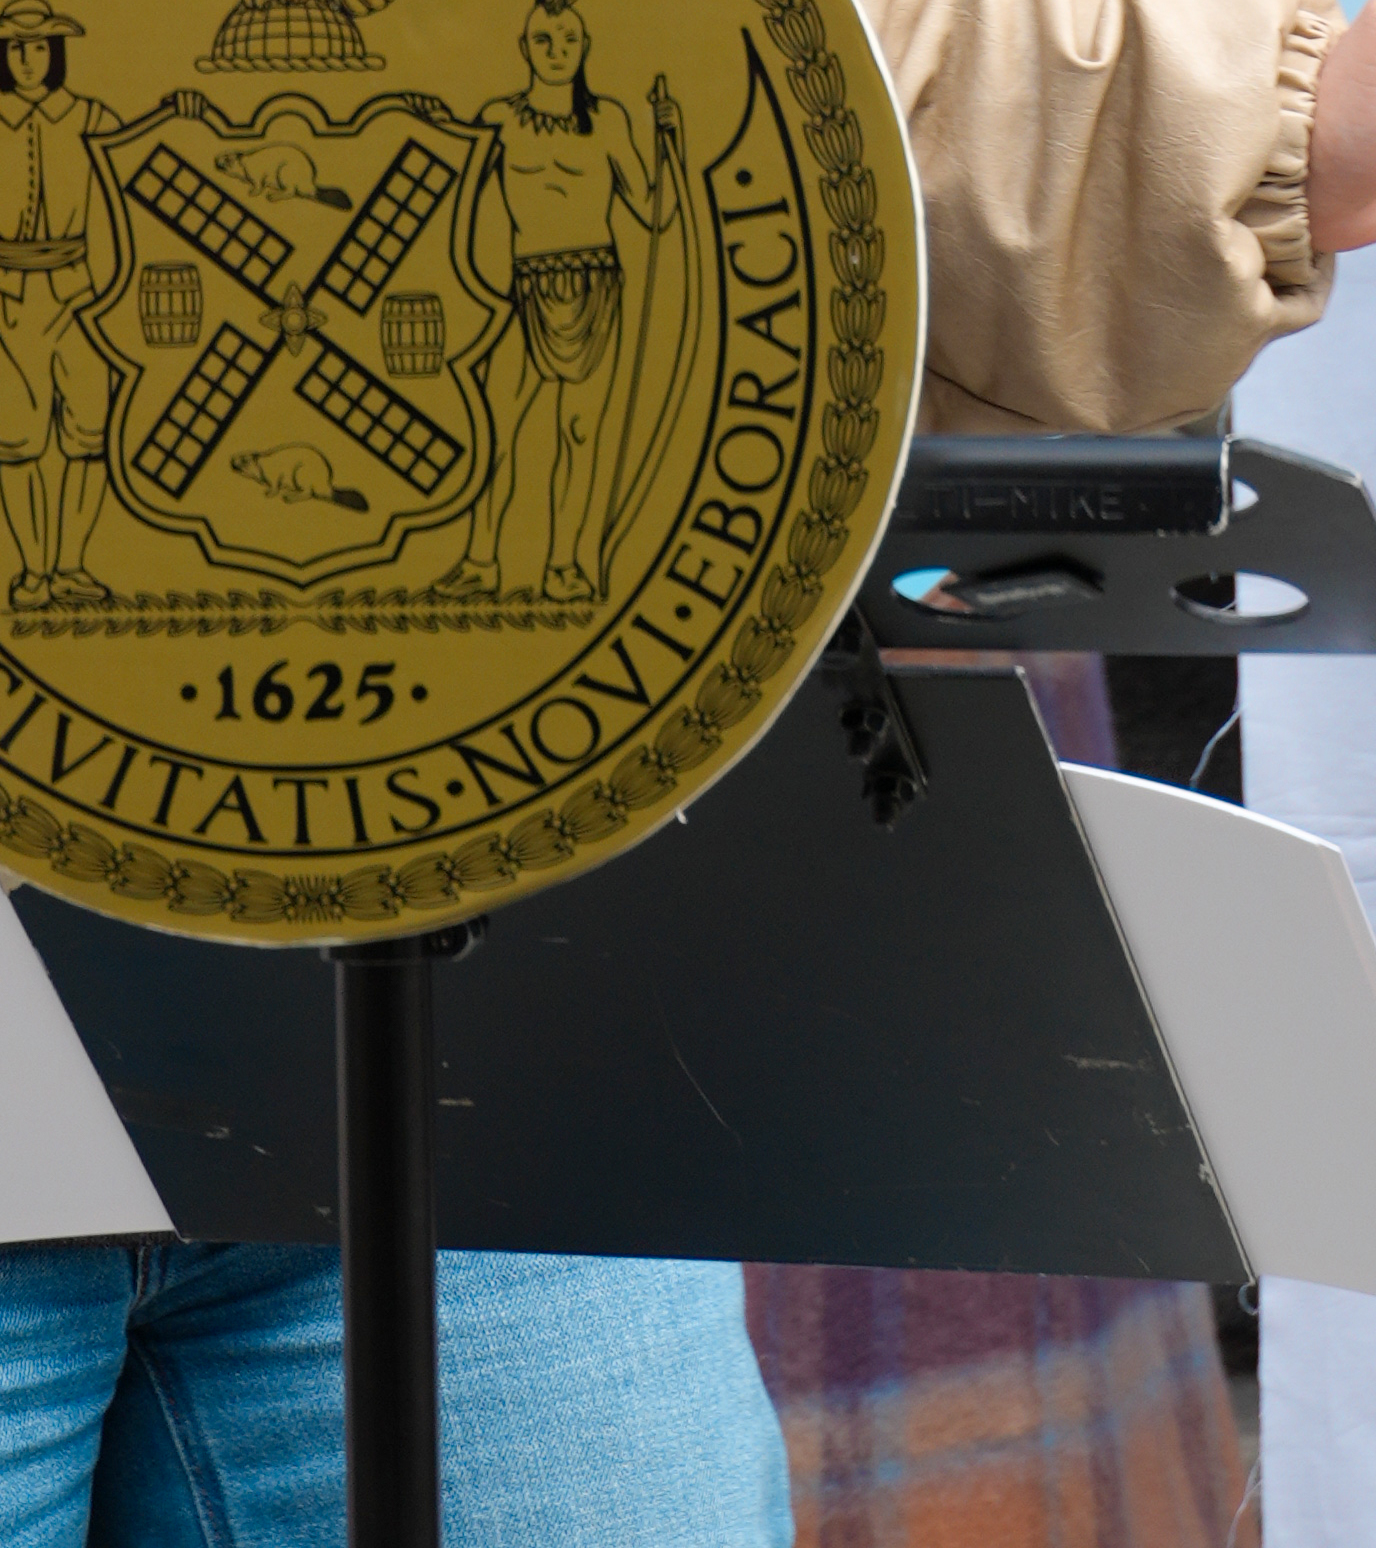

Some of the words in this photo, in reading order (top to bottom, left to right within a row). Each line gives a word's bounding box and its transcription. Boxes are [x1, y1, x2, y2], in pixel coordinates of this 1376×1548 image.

[471, 617, 697, 810] NOVI
[673, 205, 801, 607] EBORACI
[212, 661, 401, 724] 1625
